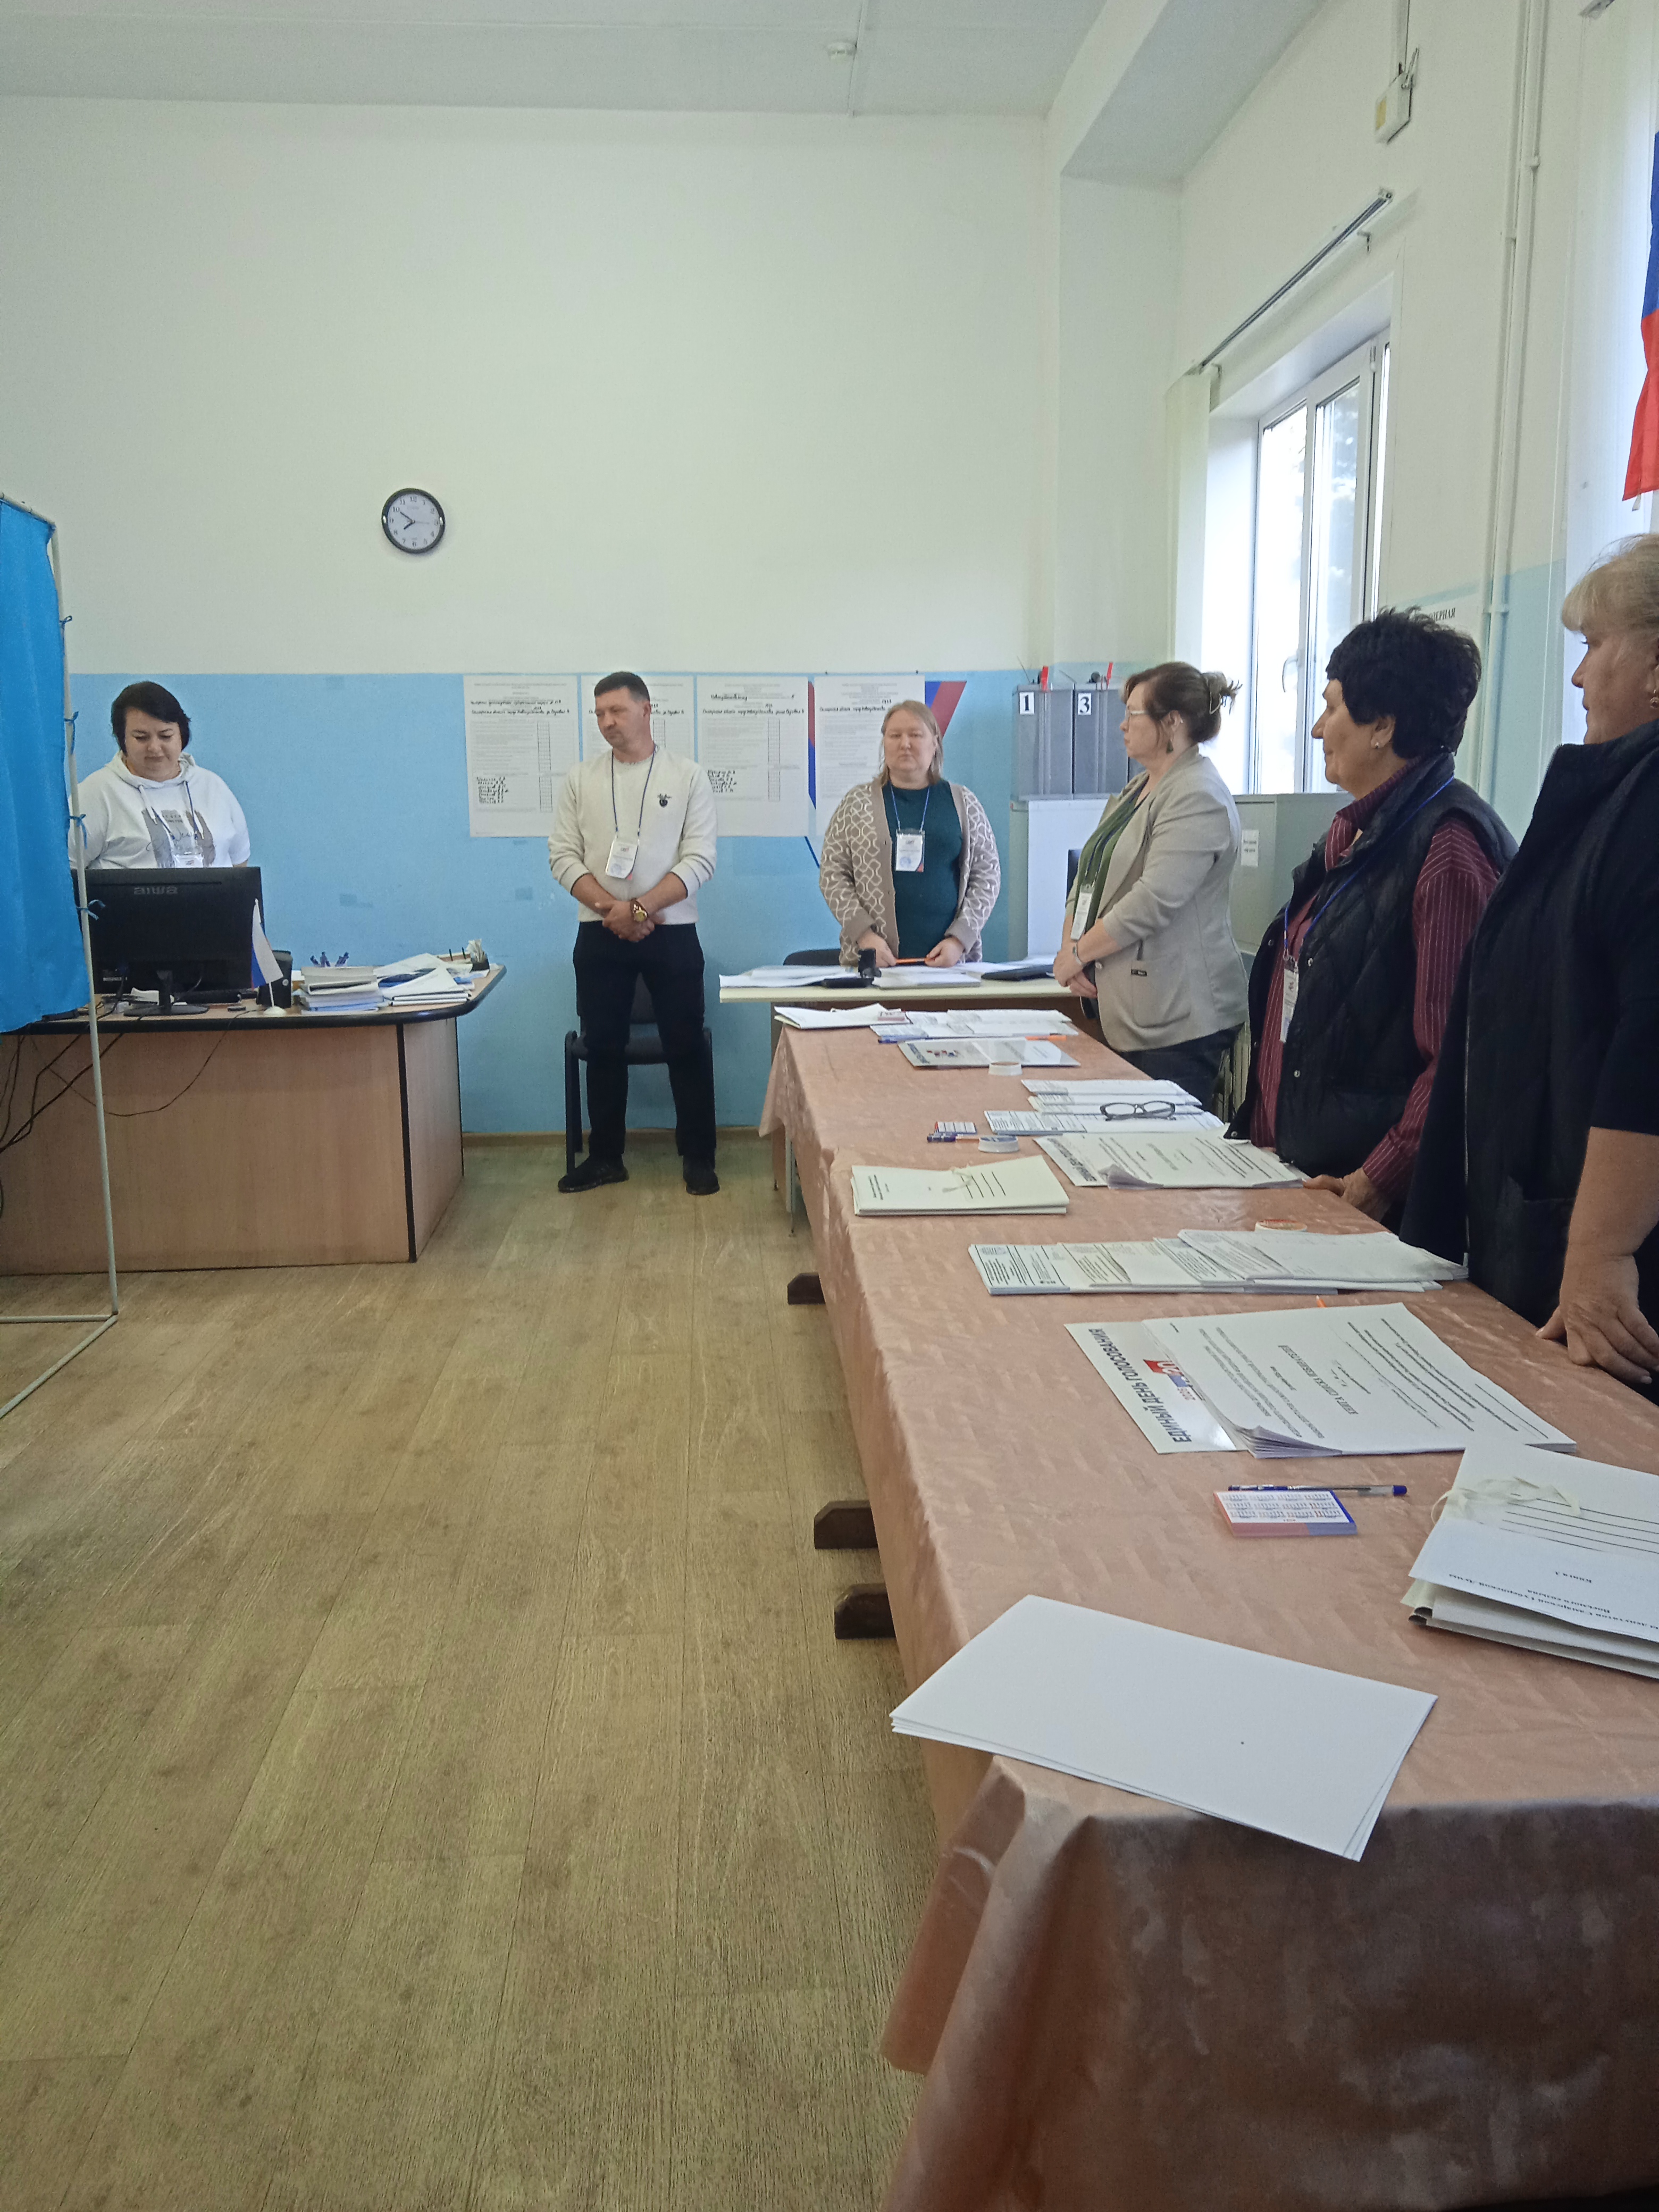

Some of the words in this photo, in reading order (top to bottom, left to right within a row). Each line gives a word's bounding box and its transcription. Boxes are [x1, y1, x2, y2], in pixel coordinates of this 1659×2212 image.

[1024, 694, 1030, 711] 1
[1079, 696, 1090, 714] 3
[133, 886, 178, 895] aiwa
[1088, 1328, 1142, 1381] ГОЛОСОВАНИЯ
[1132, 1382, 1164, 1404] ДЕНЬ
[1143, 1405, 1192, 1443] ЕДИНЫЙ
